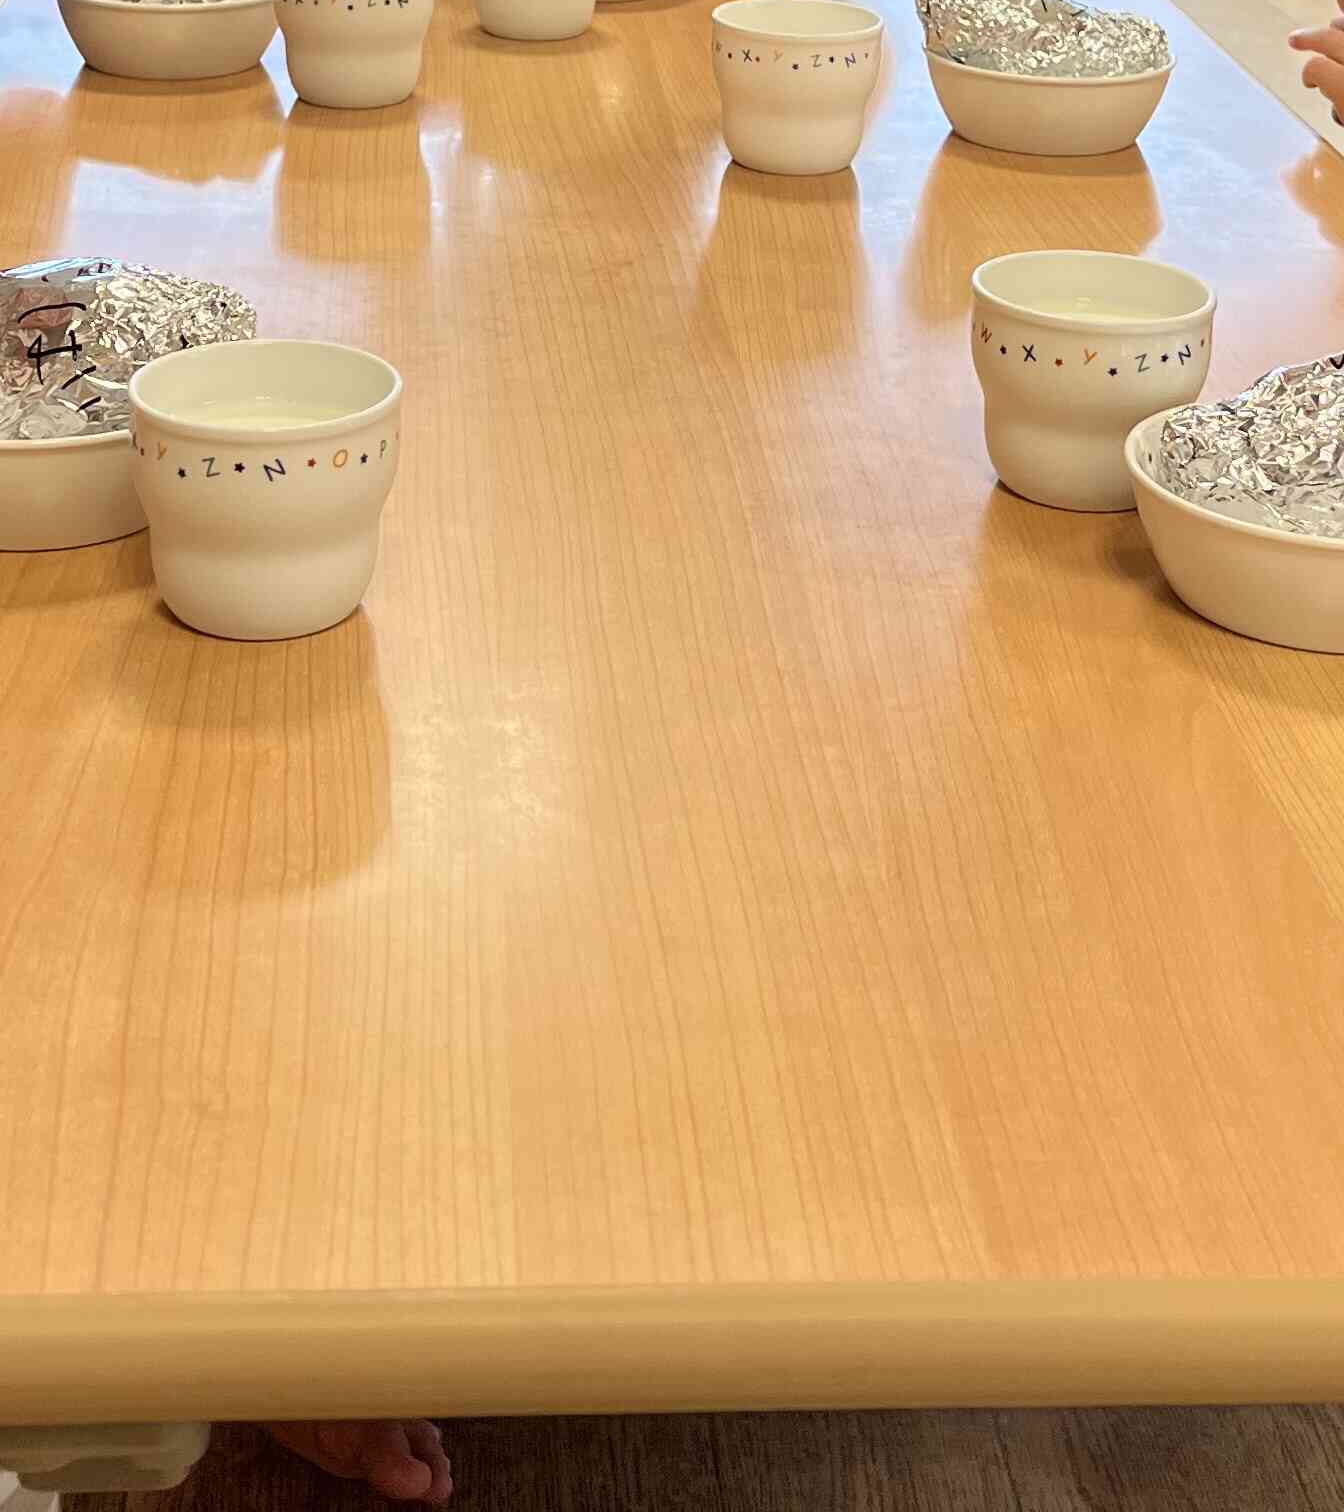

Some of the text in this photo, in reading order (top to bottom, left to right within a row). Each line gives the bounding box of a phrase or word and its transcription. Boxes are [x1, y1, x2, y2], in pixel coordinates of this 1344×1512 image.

[980, 322, 1192, 373] W X Y Z N
[201, 456, 221, 477] Z
[263, 458, 286, 482] N
[333, 448, 348, 468] O
[378, 439, 388, 460] P
